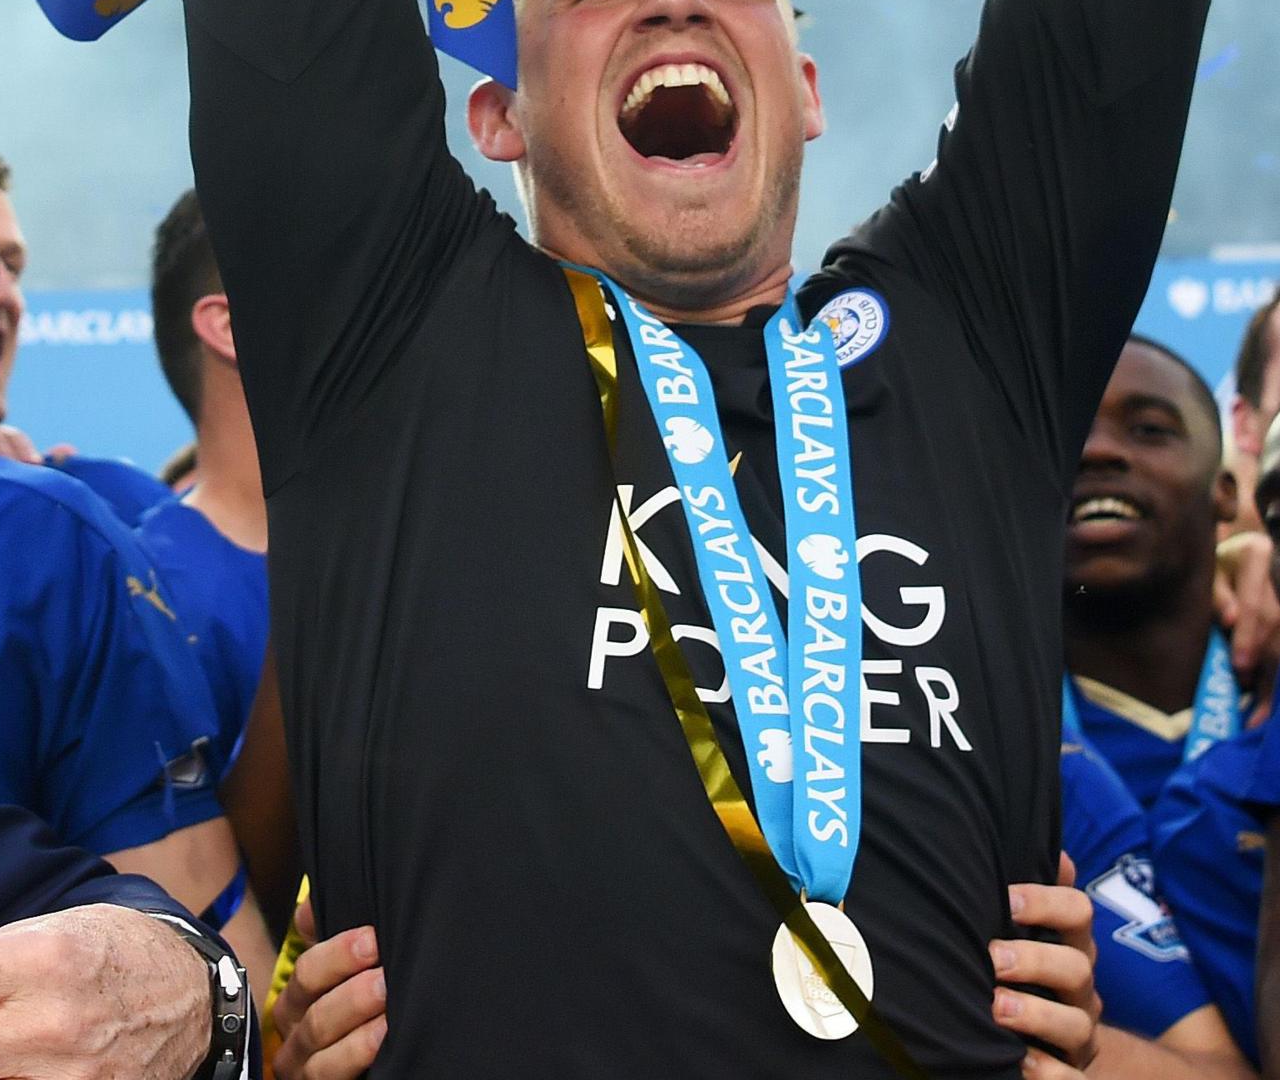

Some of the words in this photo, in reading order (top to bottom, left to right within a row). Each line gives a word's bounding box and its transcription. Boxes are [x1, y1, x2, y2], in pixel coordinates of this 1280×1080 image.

[18, 308, 157, 345] BARCLAY
[683, 484, 791, 716] BARCLAYS
[799, 586, 849, 848] BARCLAYS
